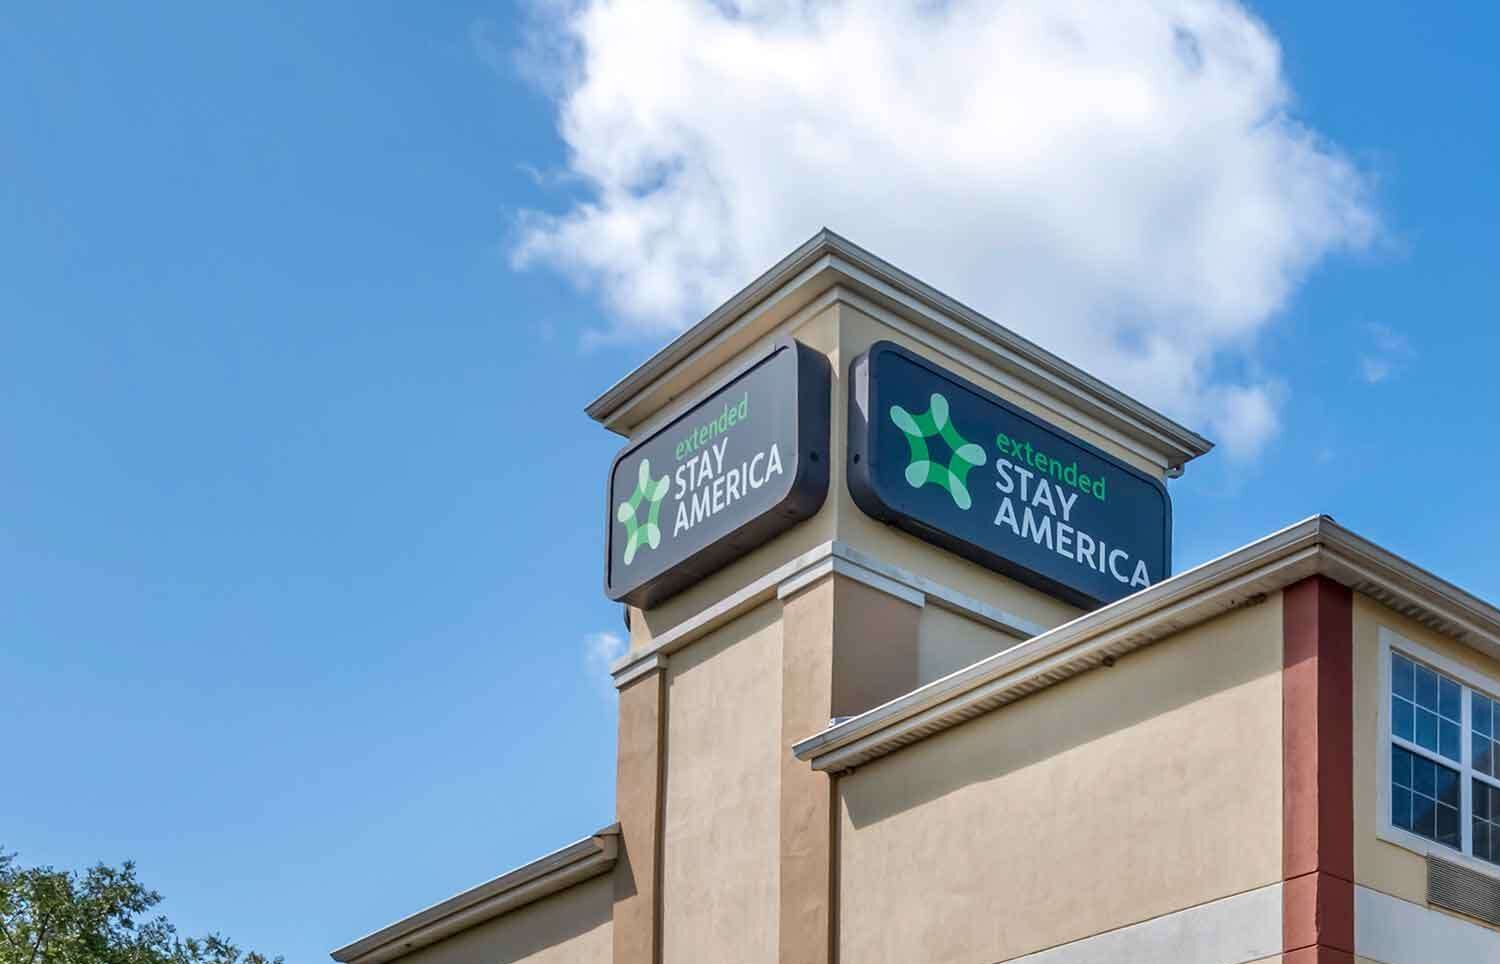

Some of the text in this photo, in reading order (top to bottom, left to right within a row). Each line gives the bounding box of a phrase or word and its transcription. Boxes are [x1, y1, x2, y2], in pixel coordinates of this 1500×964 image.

[676, 392, 749, 461] extended
[673, 443, 784, 537] AMERICA
[675, 437, 728, 500] STAY
[995, 458, 1079, 522] STAY
[996, 432, 1106, 501] extended
[993, 496, 1152, 589] AMERICA
